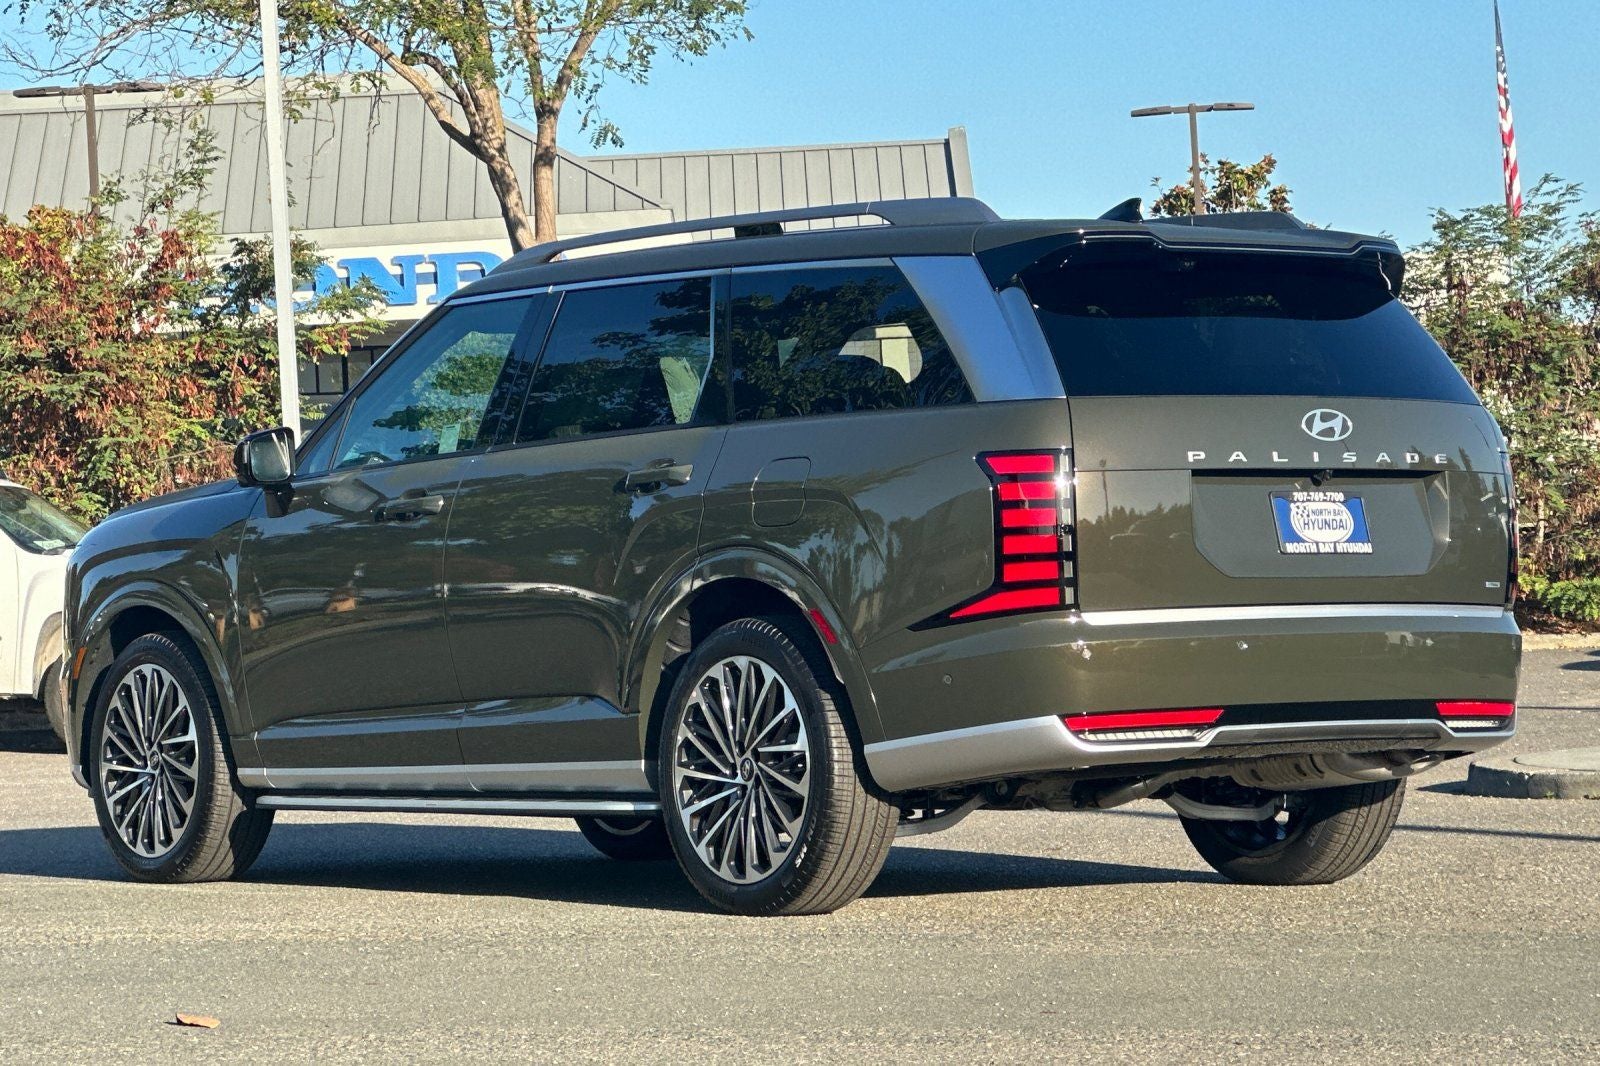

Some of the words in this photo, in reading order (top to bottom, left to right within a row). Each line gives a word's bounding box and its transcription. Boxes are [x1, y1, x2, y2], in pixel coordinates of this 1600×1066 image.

[1187, 450, 1448, 464] PALISADE
[1311, 508, 1332, 517] NORTH
[1333, 508, 1344, 517] BAY
[1303, 518, 1348, 531] HYUNDAI
[1286, 542, 1317, 554] NORTH
[1319, 542, 1335, 554] BAY
[1336, 542, 1373, 554] HYUNDAI
